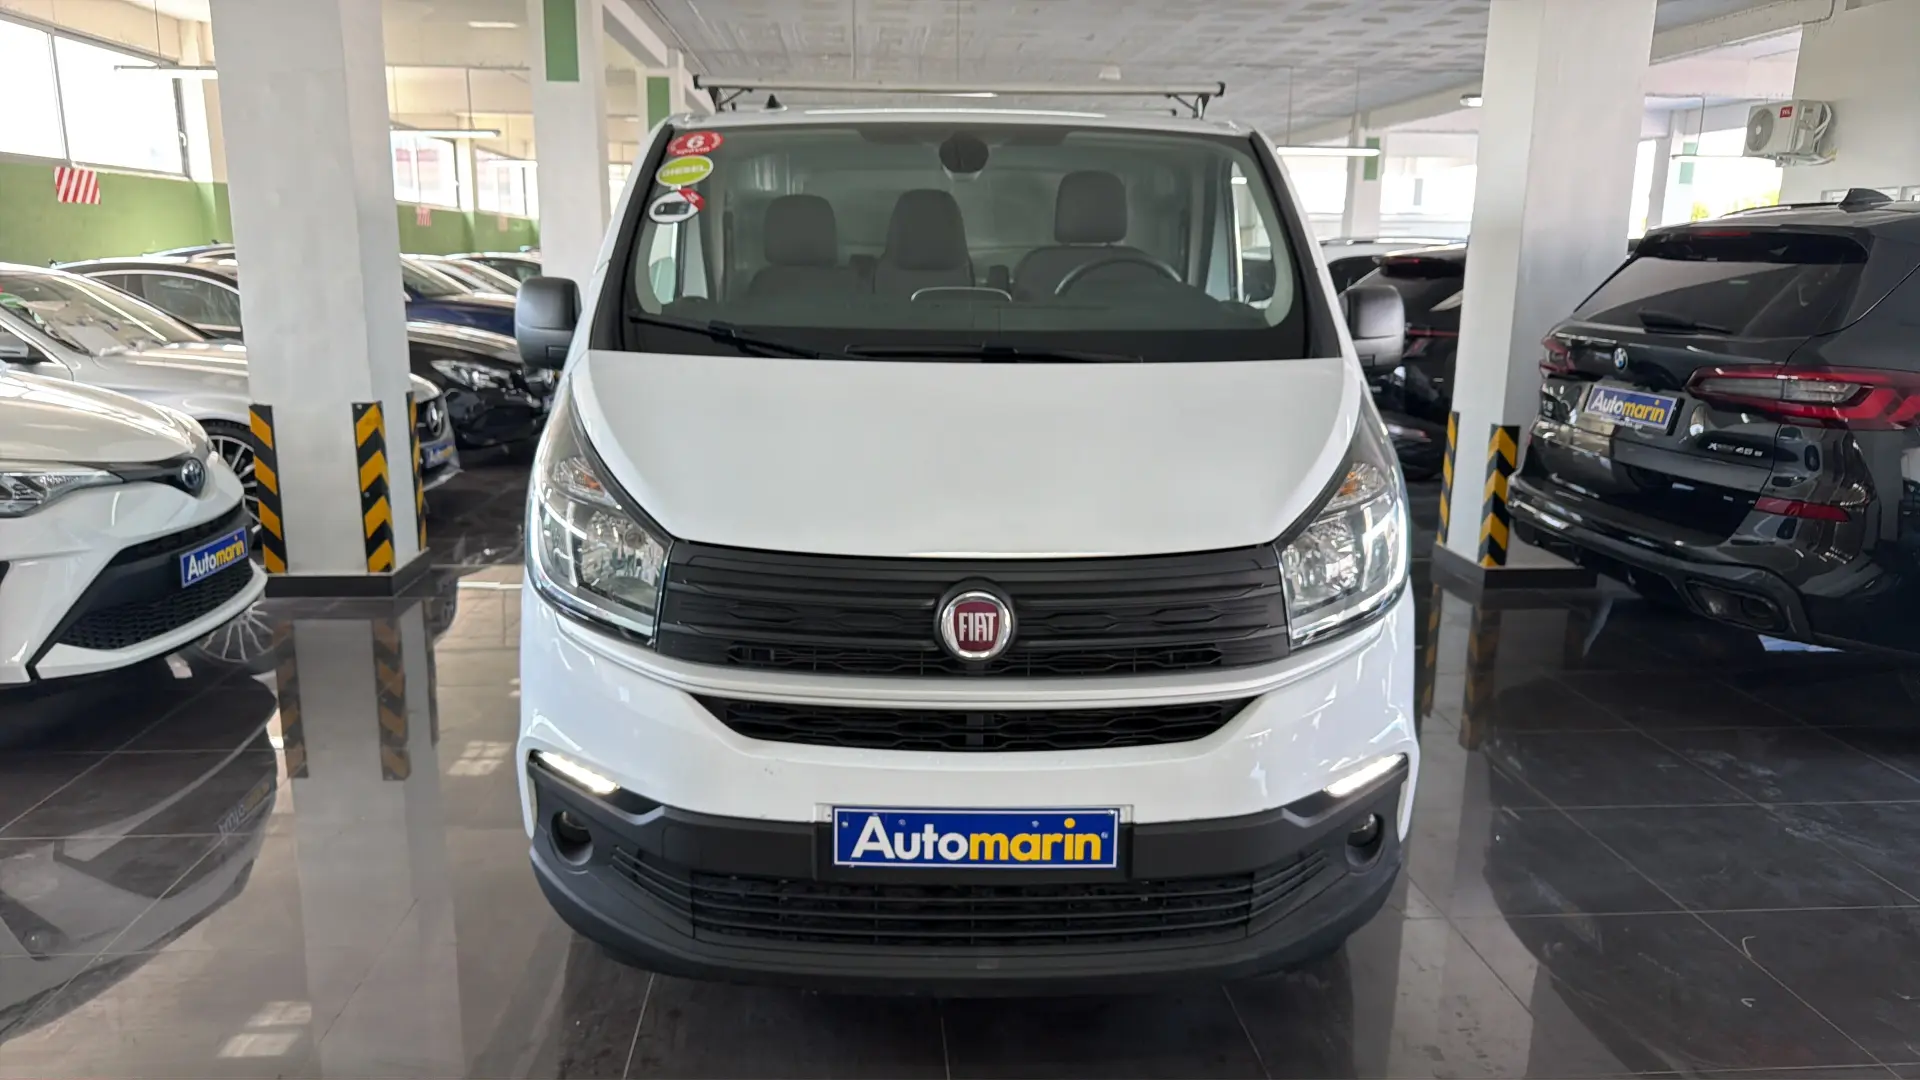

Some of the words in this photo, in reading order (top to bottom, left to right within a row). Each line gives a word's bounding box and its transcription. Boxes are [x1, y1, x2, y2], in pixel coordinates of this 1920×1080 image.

[1590, 390, 1665, 423] Automarin
[187, 534, 245, 580] Automarin
[958, 612, 997, 642] FIAT
[851, 815, 1101, 861] Automarin
